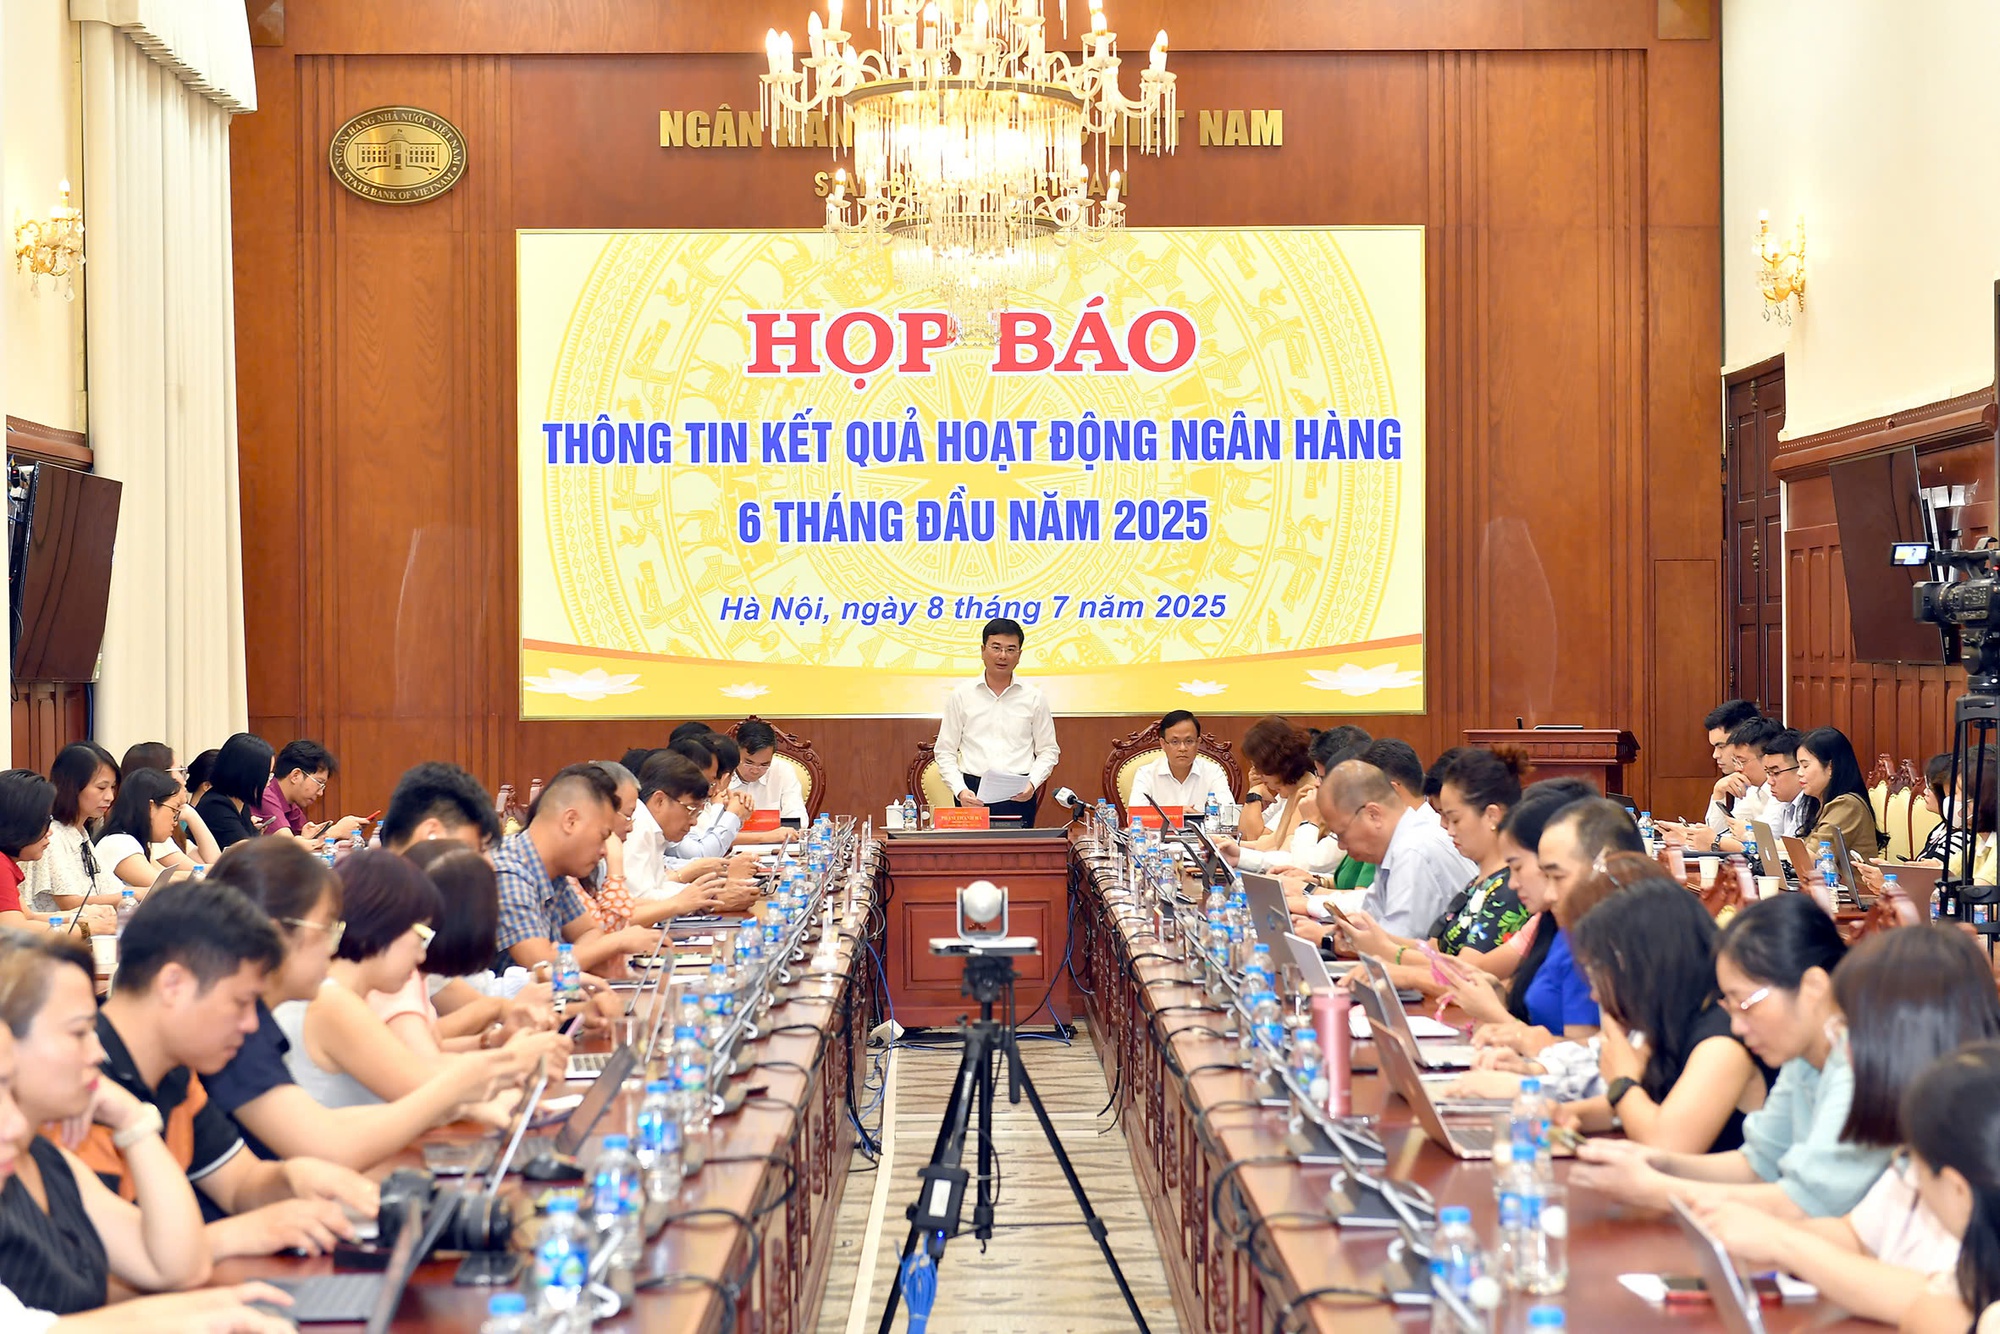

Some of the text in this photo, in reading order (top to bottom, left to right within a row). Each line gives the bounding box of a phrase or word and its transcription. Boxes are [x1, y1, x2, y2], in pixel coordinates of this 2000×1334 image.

[347, 116, 375, 135] HÀNG
[377, 110, 398, 121] NHÀ
[450, 139, 461, 165] NAM
[660, 102, 762, 148] NGÂN
[1199, 109, 1284, 147] NAM
[342, 172, 454, 200] STATE BANK OF VIETNAM
[746, 296, 1196, 390] HỌP BÁO
[542, 408, 1402, 472] THÔNG TIN KẾT QUẢ HOẠT ĐỘNG NGÂN HÀNG
[739, 488, 1208, 543] 6 THÁNG ĐẦU NĂM 2025
[720, 594, 1227, 627] Hà Nội, ngày 8 tháng 7 năm 2025
